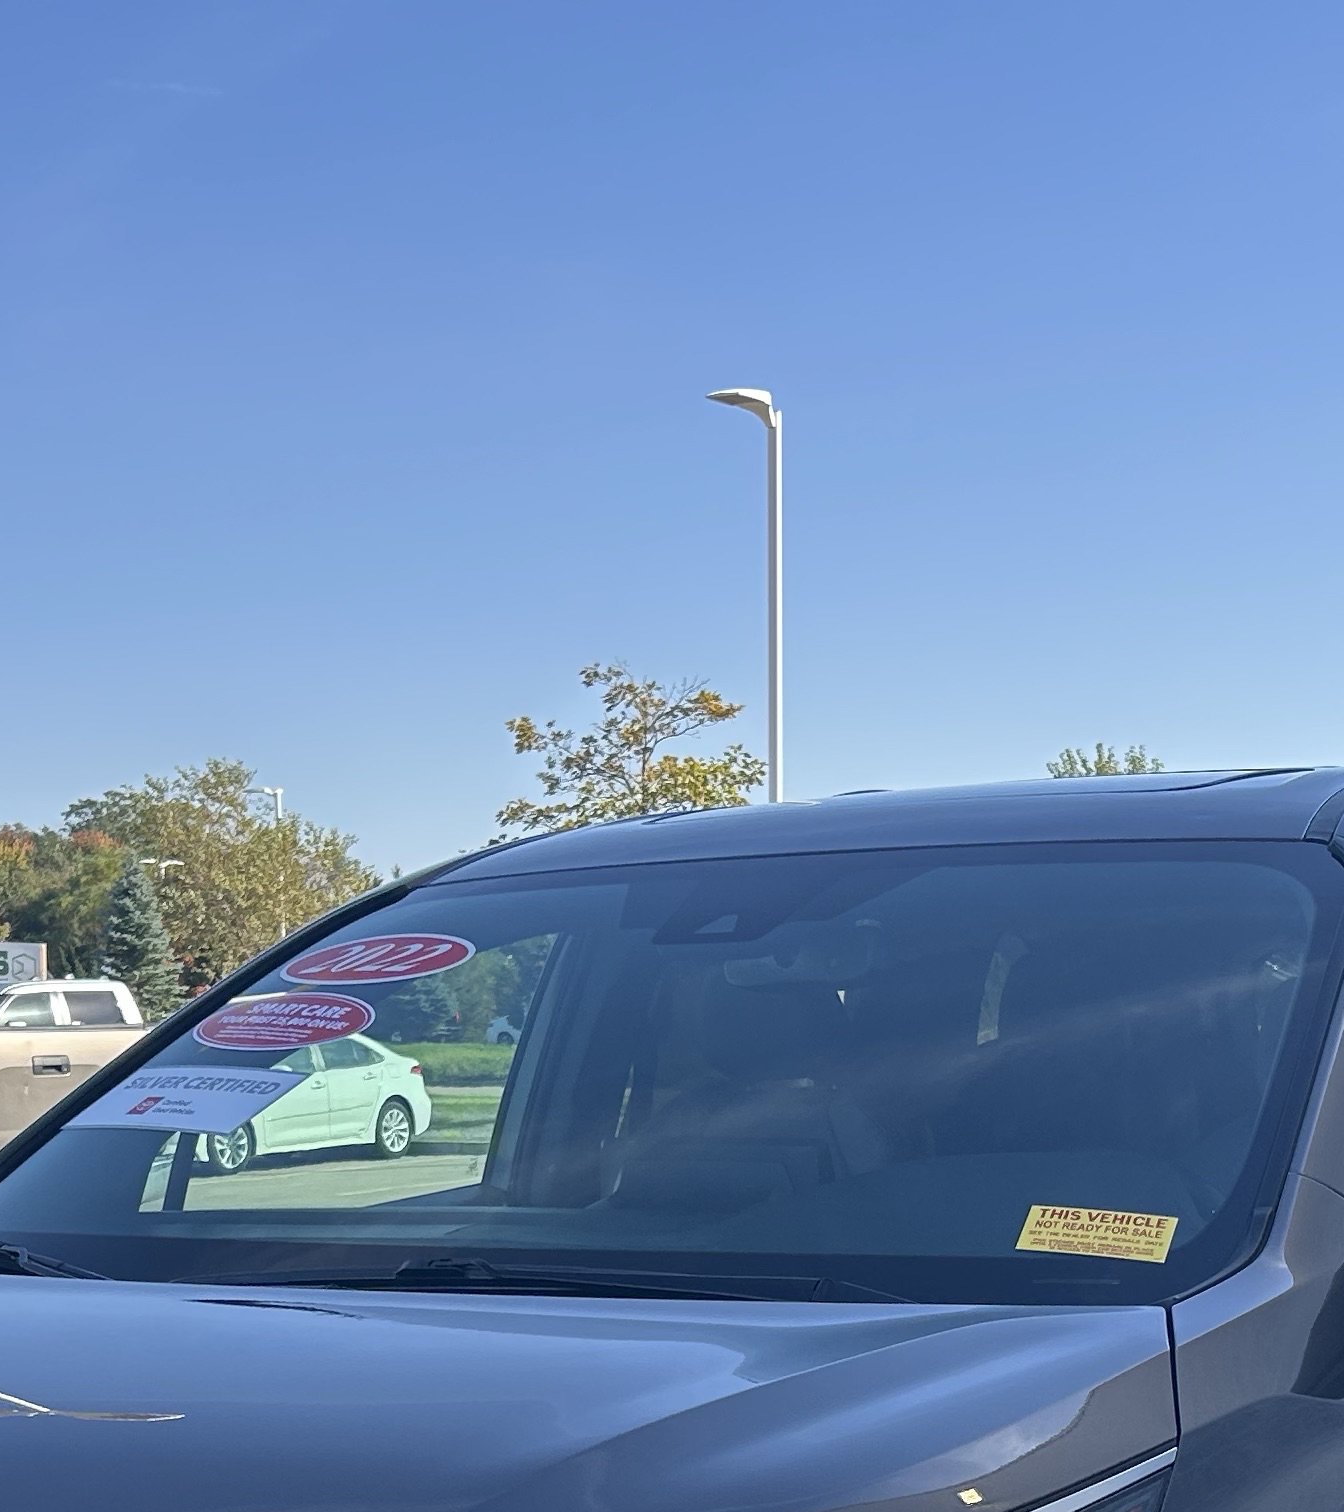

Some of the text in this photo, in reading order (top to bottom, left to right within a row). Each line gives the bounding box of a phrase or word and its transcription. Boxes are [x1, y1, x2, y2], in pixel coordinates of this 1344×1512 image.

[298, 944, 453, 974] 2022
[124, 1076, 281, 1095] SILVER CERTIFIED
[1039, 1208, 1168, 1229] THIS VEHICLE
[1035, 1220, 1164, 1239] NOT READY FOR SALE
